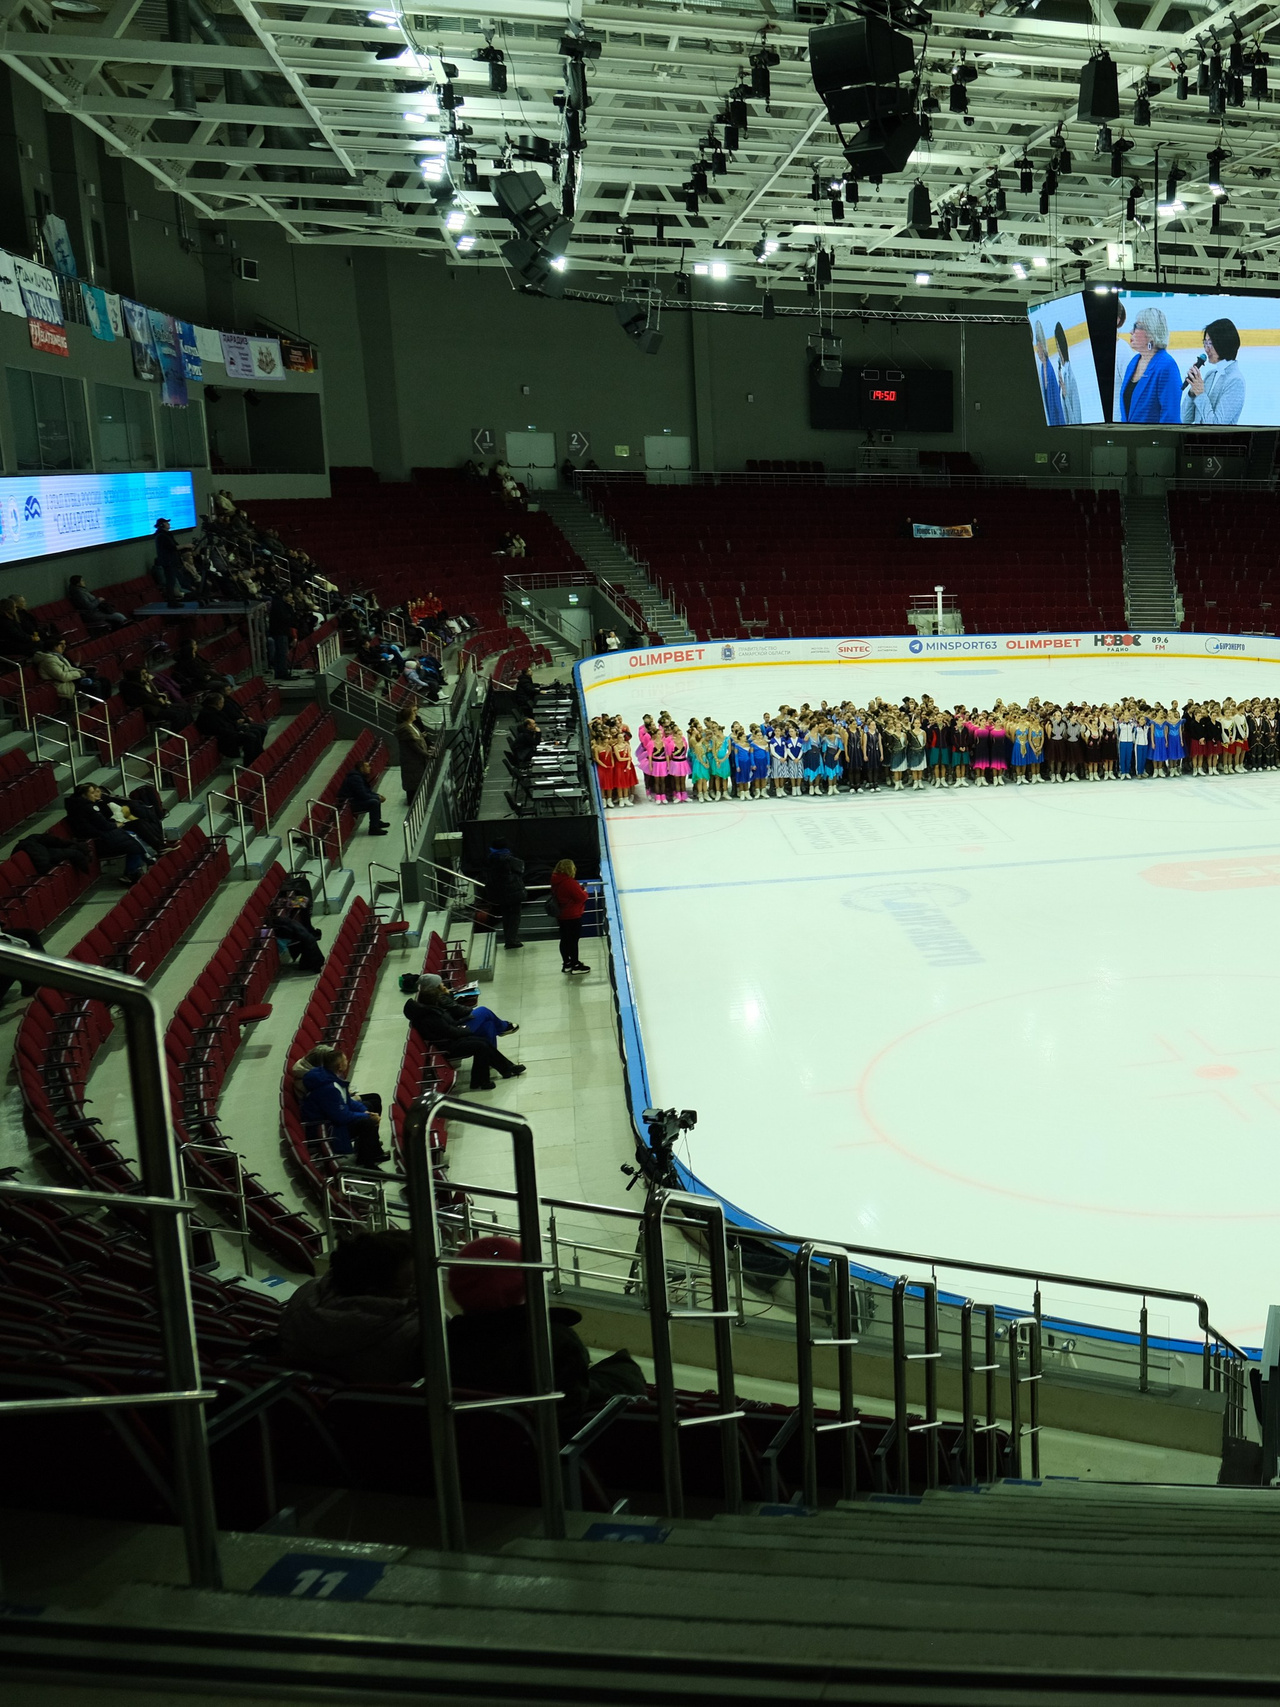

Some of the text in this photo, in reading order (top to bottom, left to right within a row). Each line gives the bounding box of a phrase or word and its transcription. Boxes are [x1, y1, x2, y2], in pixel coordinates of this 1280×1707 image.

[873, 390, 897, 402] 19:50
[485, 431, 490, 443] 1
[571, 433, 579, 445] 2
[1060, 453, 1067, 463] 2
[1207, 457, 1213, 468] 3
[838, 645, 871, 653] SINTEC
[926, 641, 997, 651] MINSPORT63
[1006, 638, 1082, 650] OLIMPBET
[1220, 642, 1246, 651] БУРЭНЕРГО
[629, 649, 705, 668] OLIMPBET
[289, 1568, 349, 1598] 11
